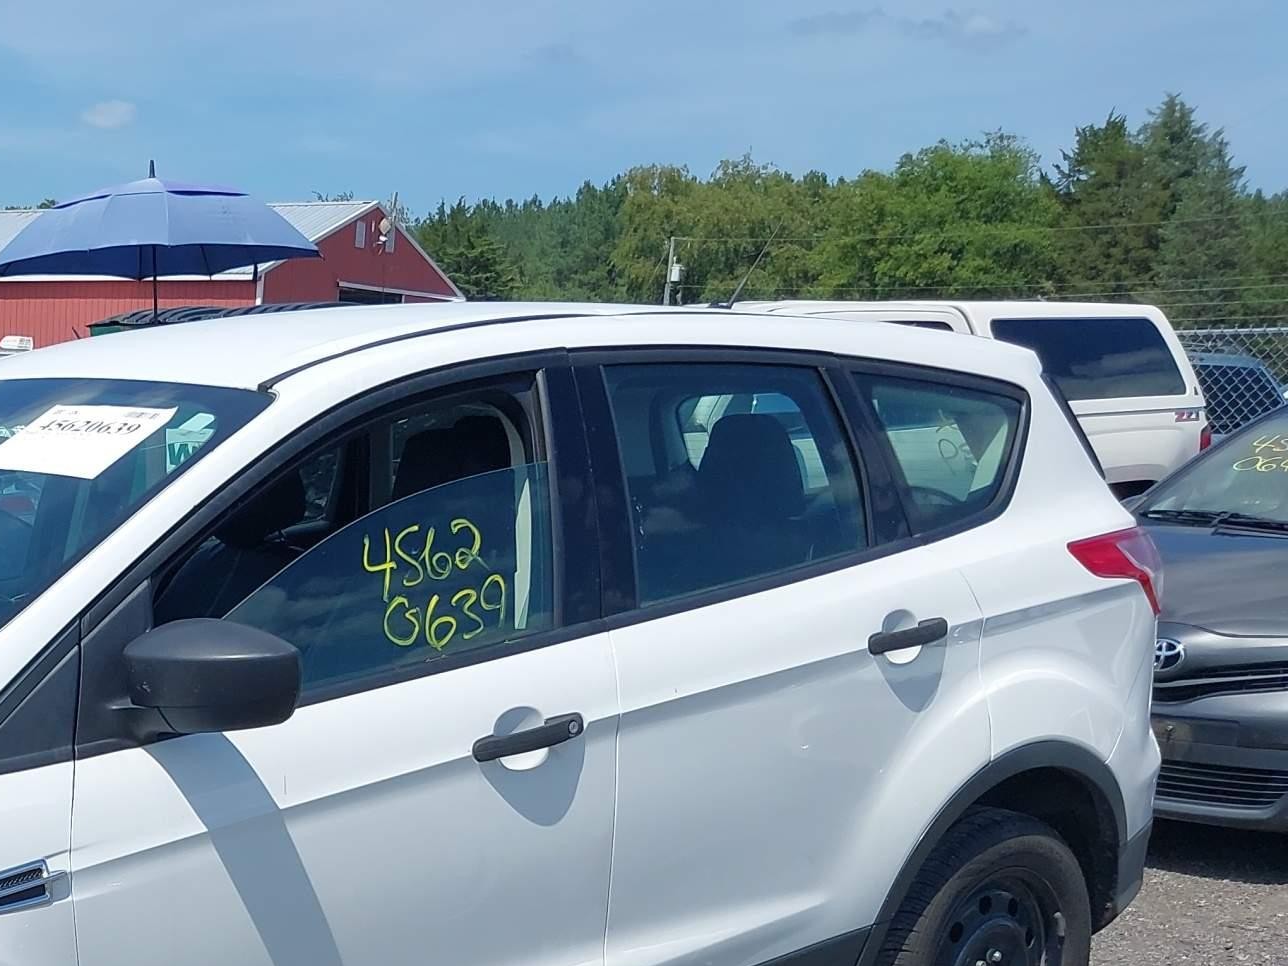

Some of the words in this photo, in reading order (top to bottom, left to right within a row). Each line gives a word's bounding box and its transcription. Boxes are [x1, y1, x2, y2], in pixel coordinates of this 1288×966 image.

[40, 419, 142, 435] 45620639
[1233, 456, 1288, 472] 06
[364, 518, 485, 603] 4562
[384, 574, 505, 651] 0639
